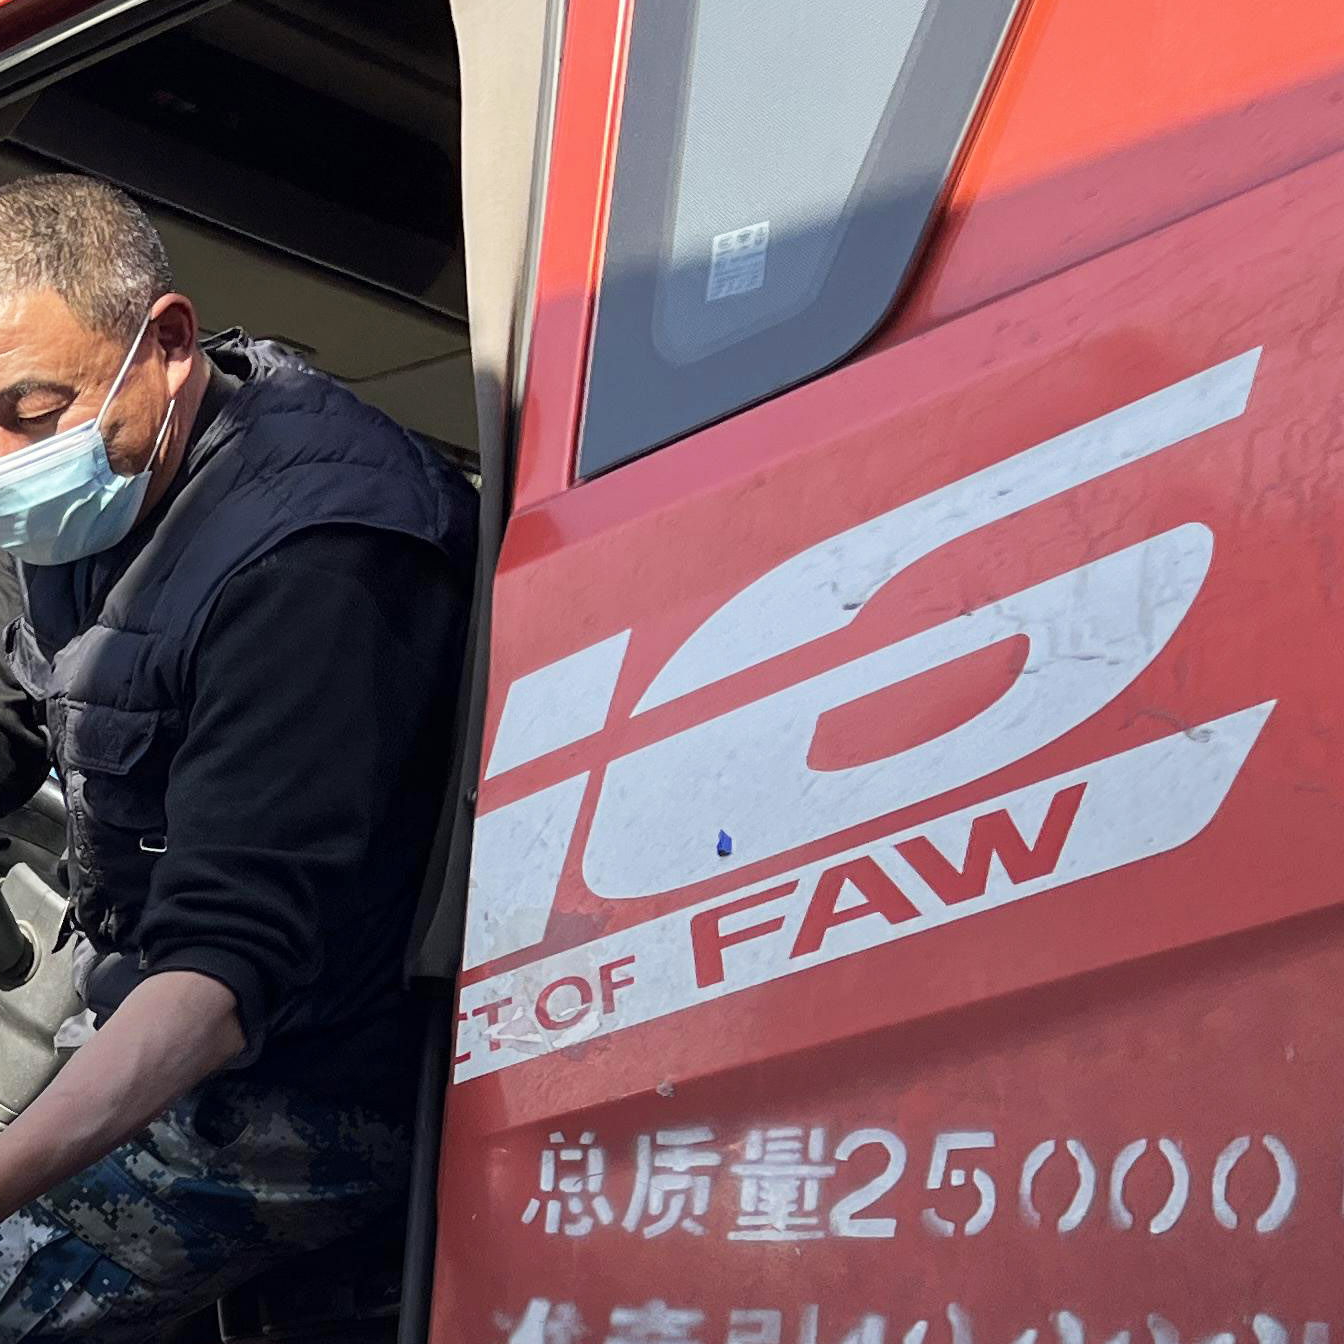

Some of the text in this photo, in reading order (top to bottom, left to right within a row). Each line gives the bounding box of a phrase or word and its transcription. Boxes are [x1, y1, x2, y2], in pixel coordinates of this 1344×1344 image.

[534, 955, 635, 1031] OF
[690, 781, 1089, 989] FAW
[521, 1126, 1298, 1243] 总质量25000
